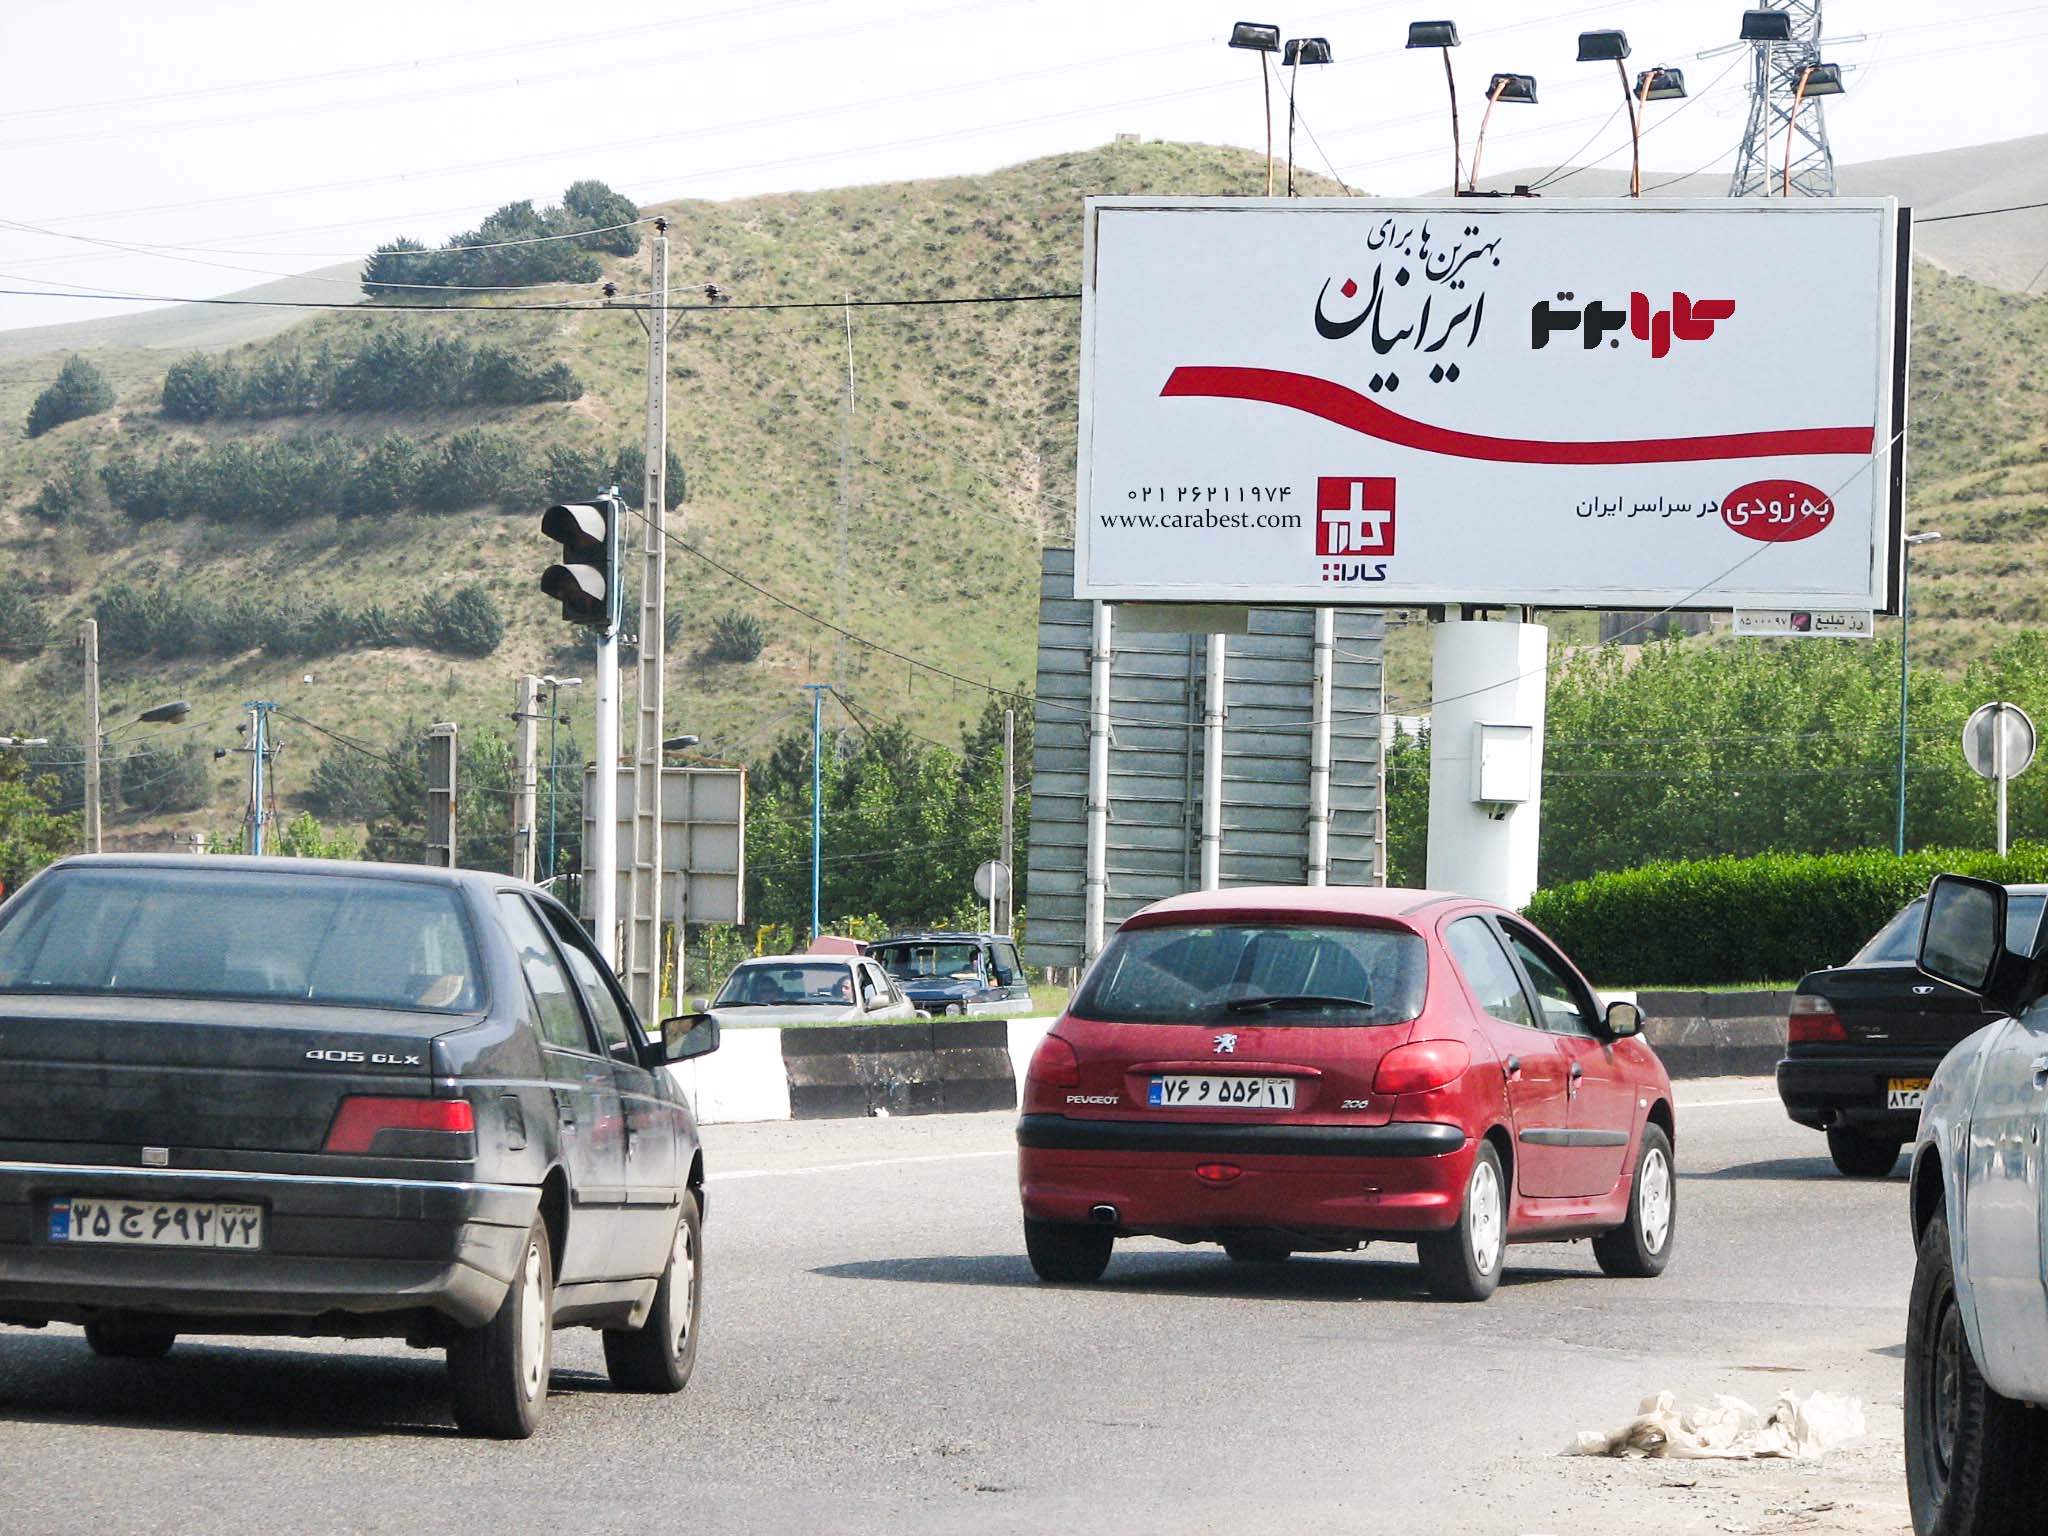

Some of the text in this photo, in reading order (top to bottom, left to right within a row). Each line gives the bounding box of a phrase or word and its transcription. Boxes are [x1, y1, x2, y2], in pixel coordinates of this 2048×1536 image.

[1367, 218, 1414, 256] برای
[1314, 262, 1486, 393] ایرانیان
[1575, 496, 1719, 518] در سراسر ایران
[1100, 508, 1303, 529] www.carabest.com
[305, 1050, 420, 1065] 405 GLX
[1066, 1095, 1120, 1105] PEUGEOT
[1340, 1099, 1369, 1109] 206
